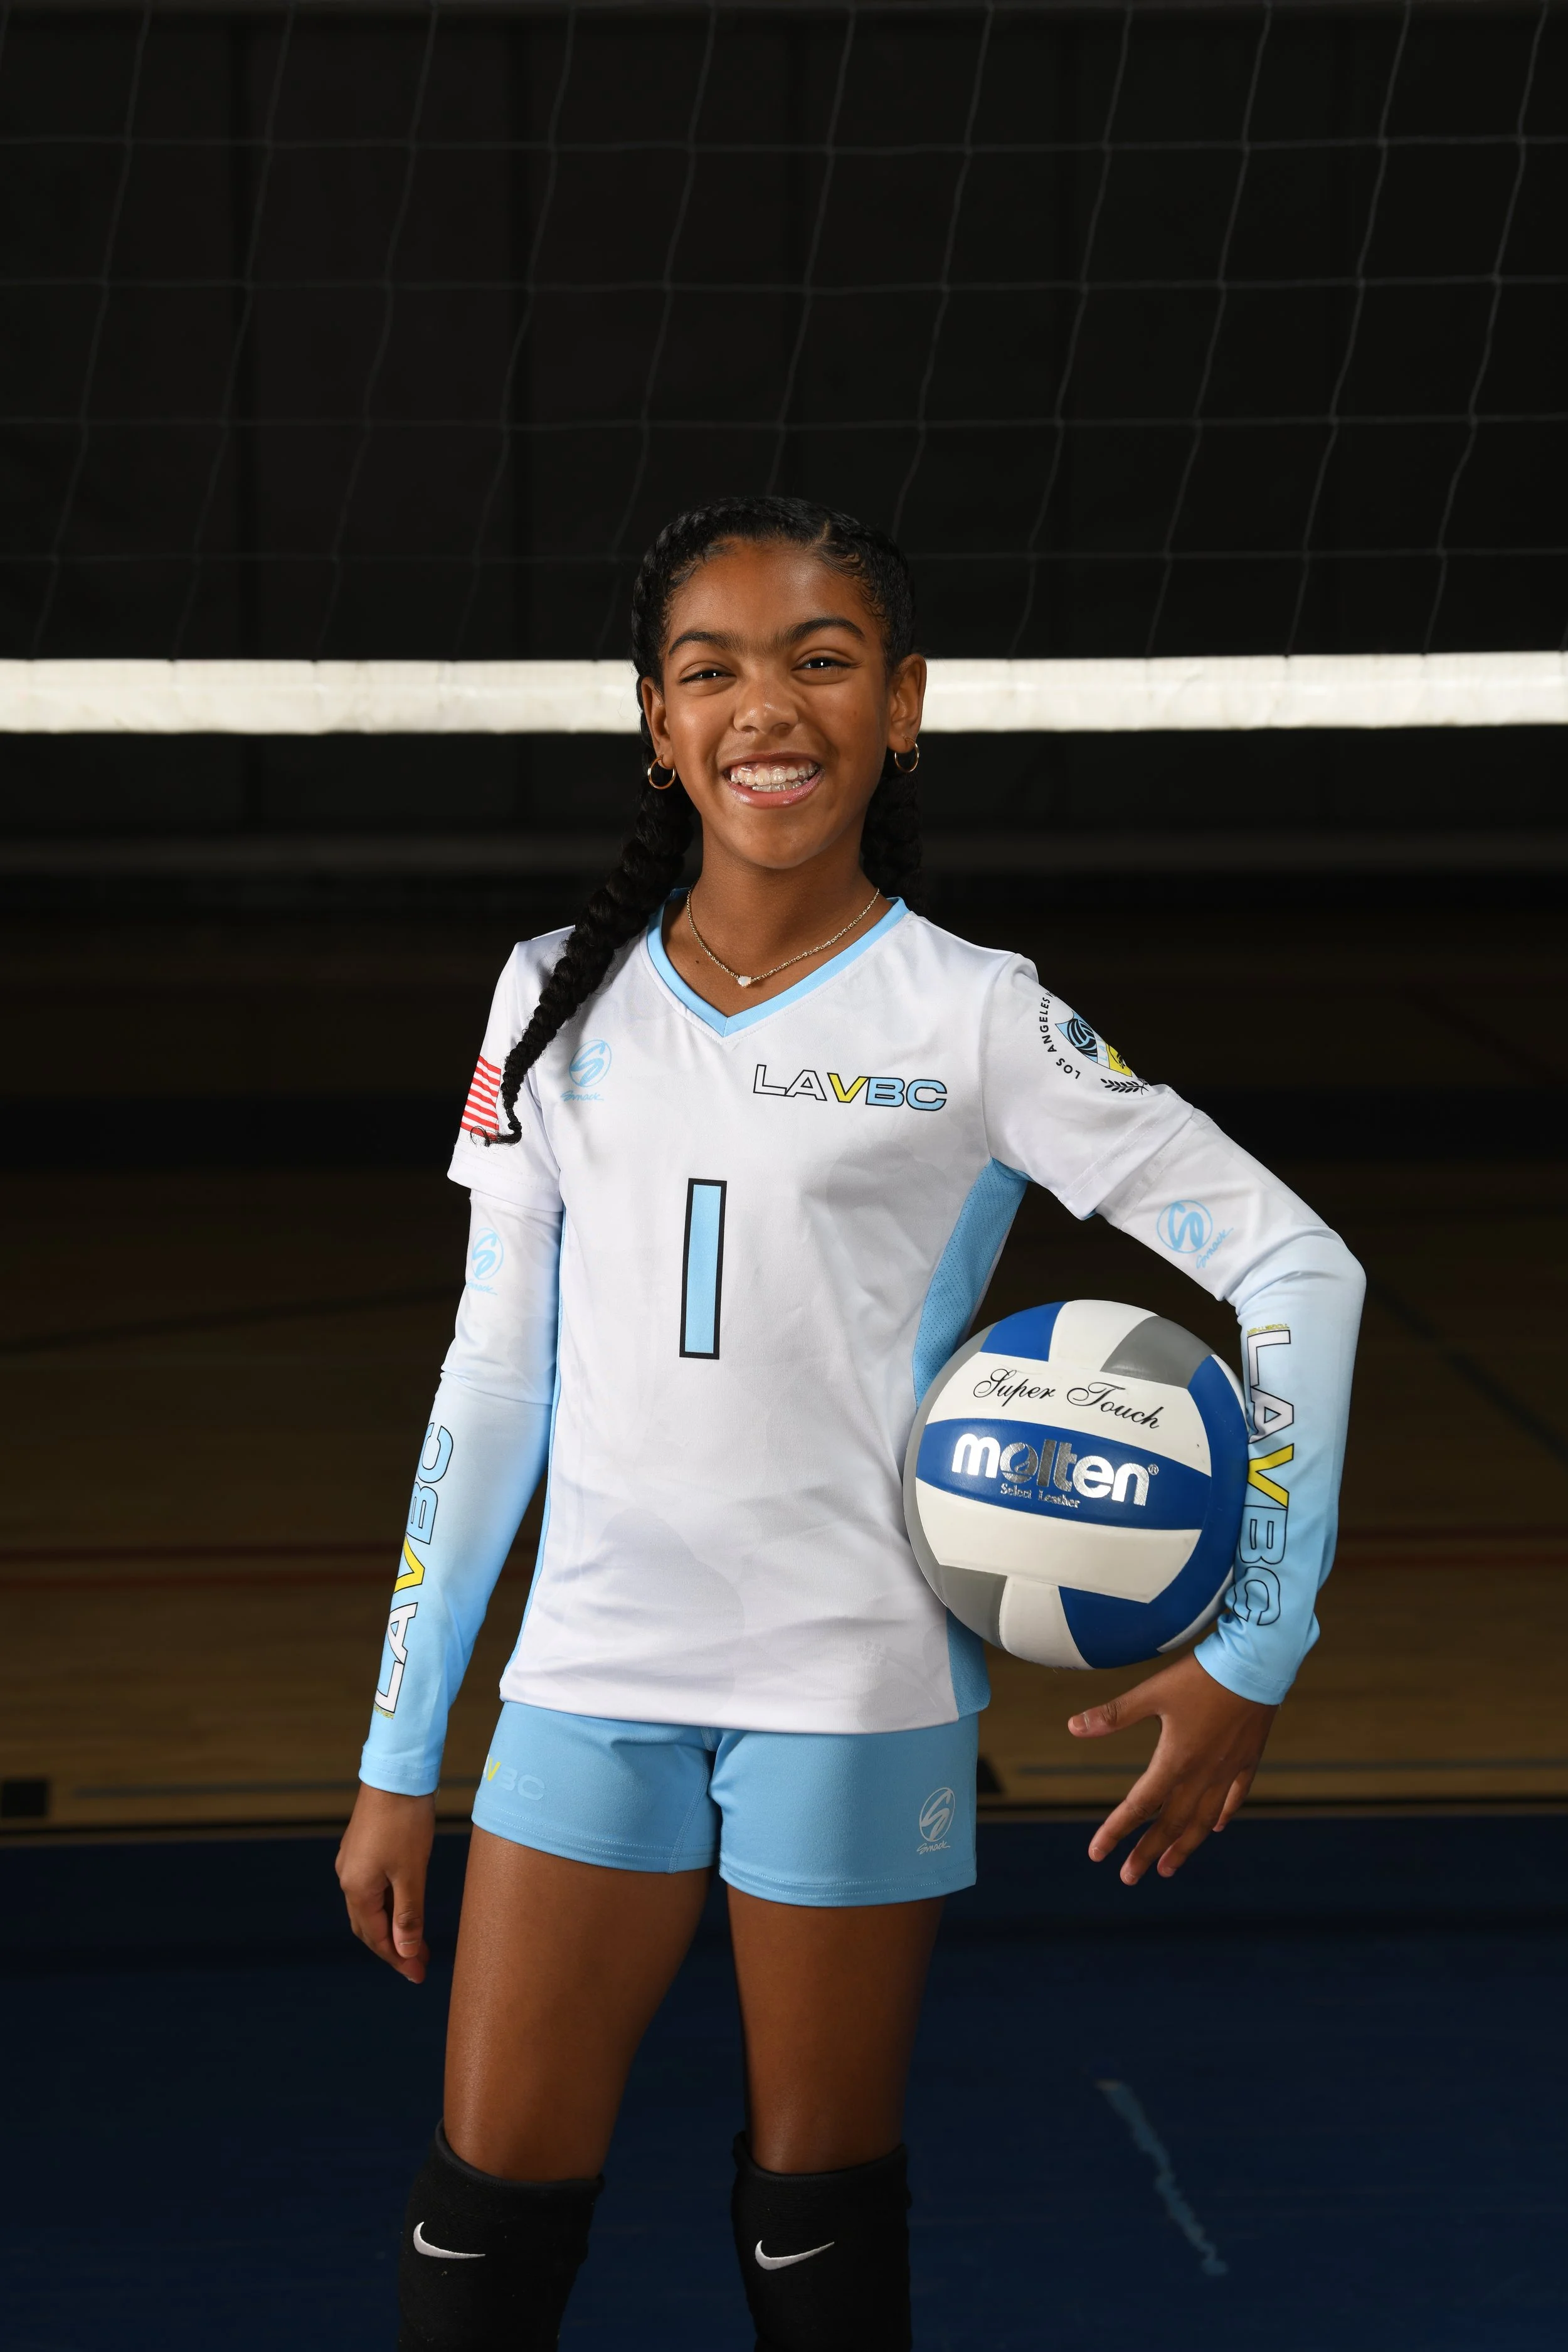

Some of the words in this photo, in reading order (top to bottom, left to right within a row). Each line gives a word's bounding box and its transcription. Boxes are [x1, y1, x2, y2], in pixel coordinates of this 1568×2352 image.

[1039, 997, 1057, 1053] ANGELES
[753, 1064, 948, 1111] LAVBC
[1056, 1058, 1081, 1079] LOS
[679, 1177, 728, 1360] 1
[973, 1369, 1057, 1407] Super
[1066, 1382, 1165, 1429] Touch
[1000, 1483, 1032, 1500] Select
[1038, 1490, 1080, 1508] Leather
[1233, 1329, 1295, 1626] LAVBC
[374, 1422, 453, 1714] LAVBC
